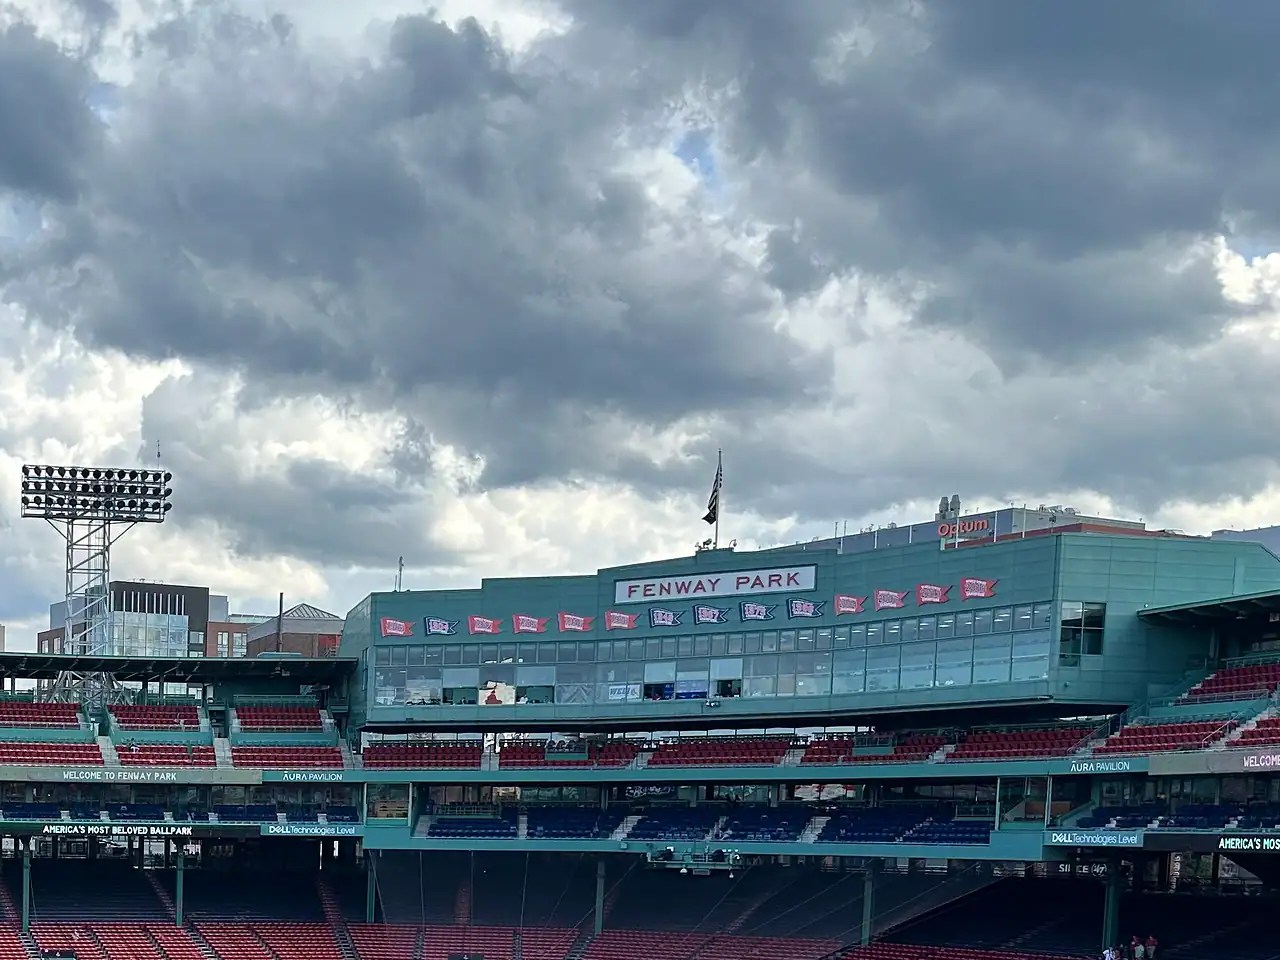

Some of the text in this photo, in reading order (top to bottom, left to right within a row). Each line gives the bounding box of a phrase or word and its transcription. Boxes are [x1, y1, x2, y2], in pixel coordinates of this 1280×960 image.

[938, 520, 988, 538] Optum
[627, 571, 800, 598] FENWAY PARK
[1096, 761, 1130, 771] PAVILION
[1243, 754, 1280, 767] WELCOME
[63, 771, 177, 781] WELCOME TO FENWAY PARK
[308, 773, 343, 781] PAVILION
[43, 825, 193, 835] AMERICA'S MOST BELOVED BALLPARK
[269, 825, 356, 836] DELL Technologies Level
[1052, 833, 1138, 845] DELL Technologies Level
[1218, 837, 1261, 850] AMERICA'S
